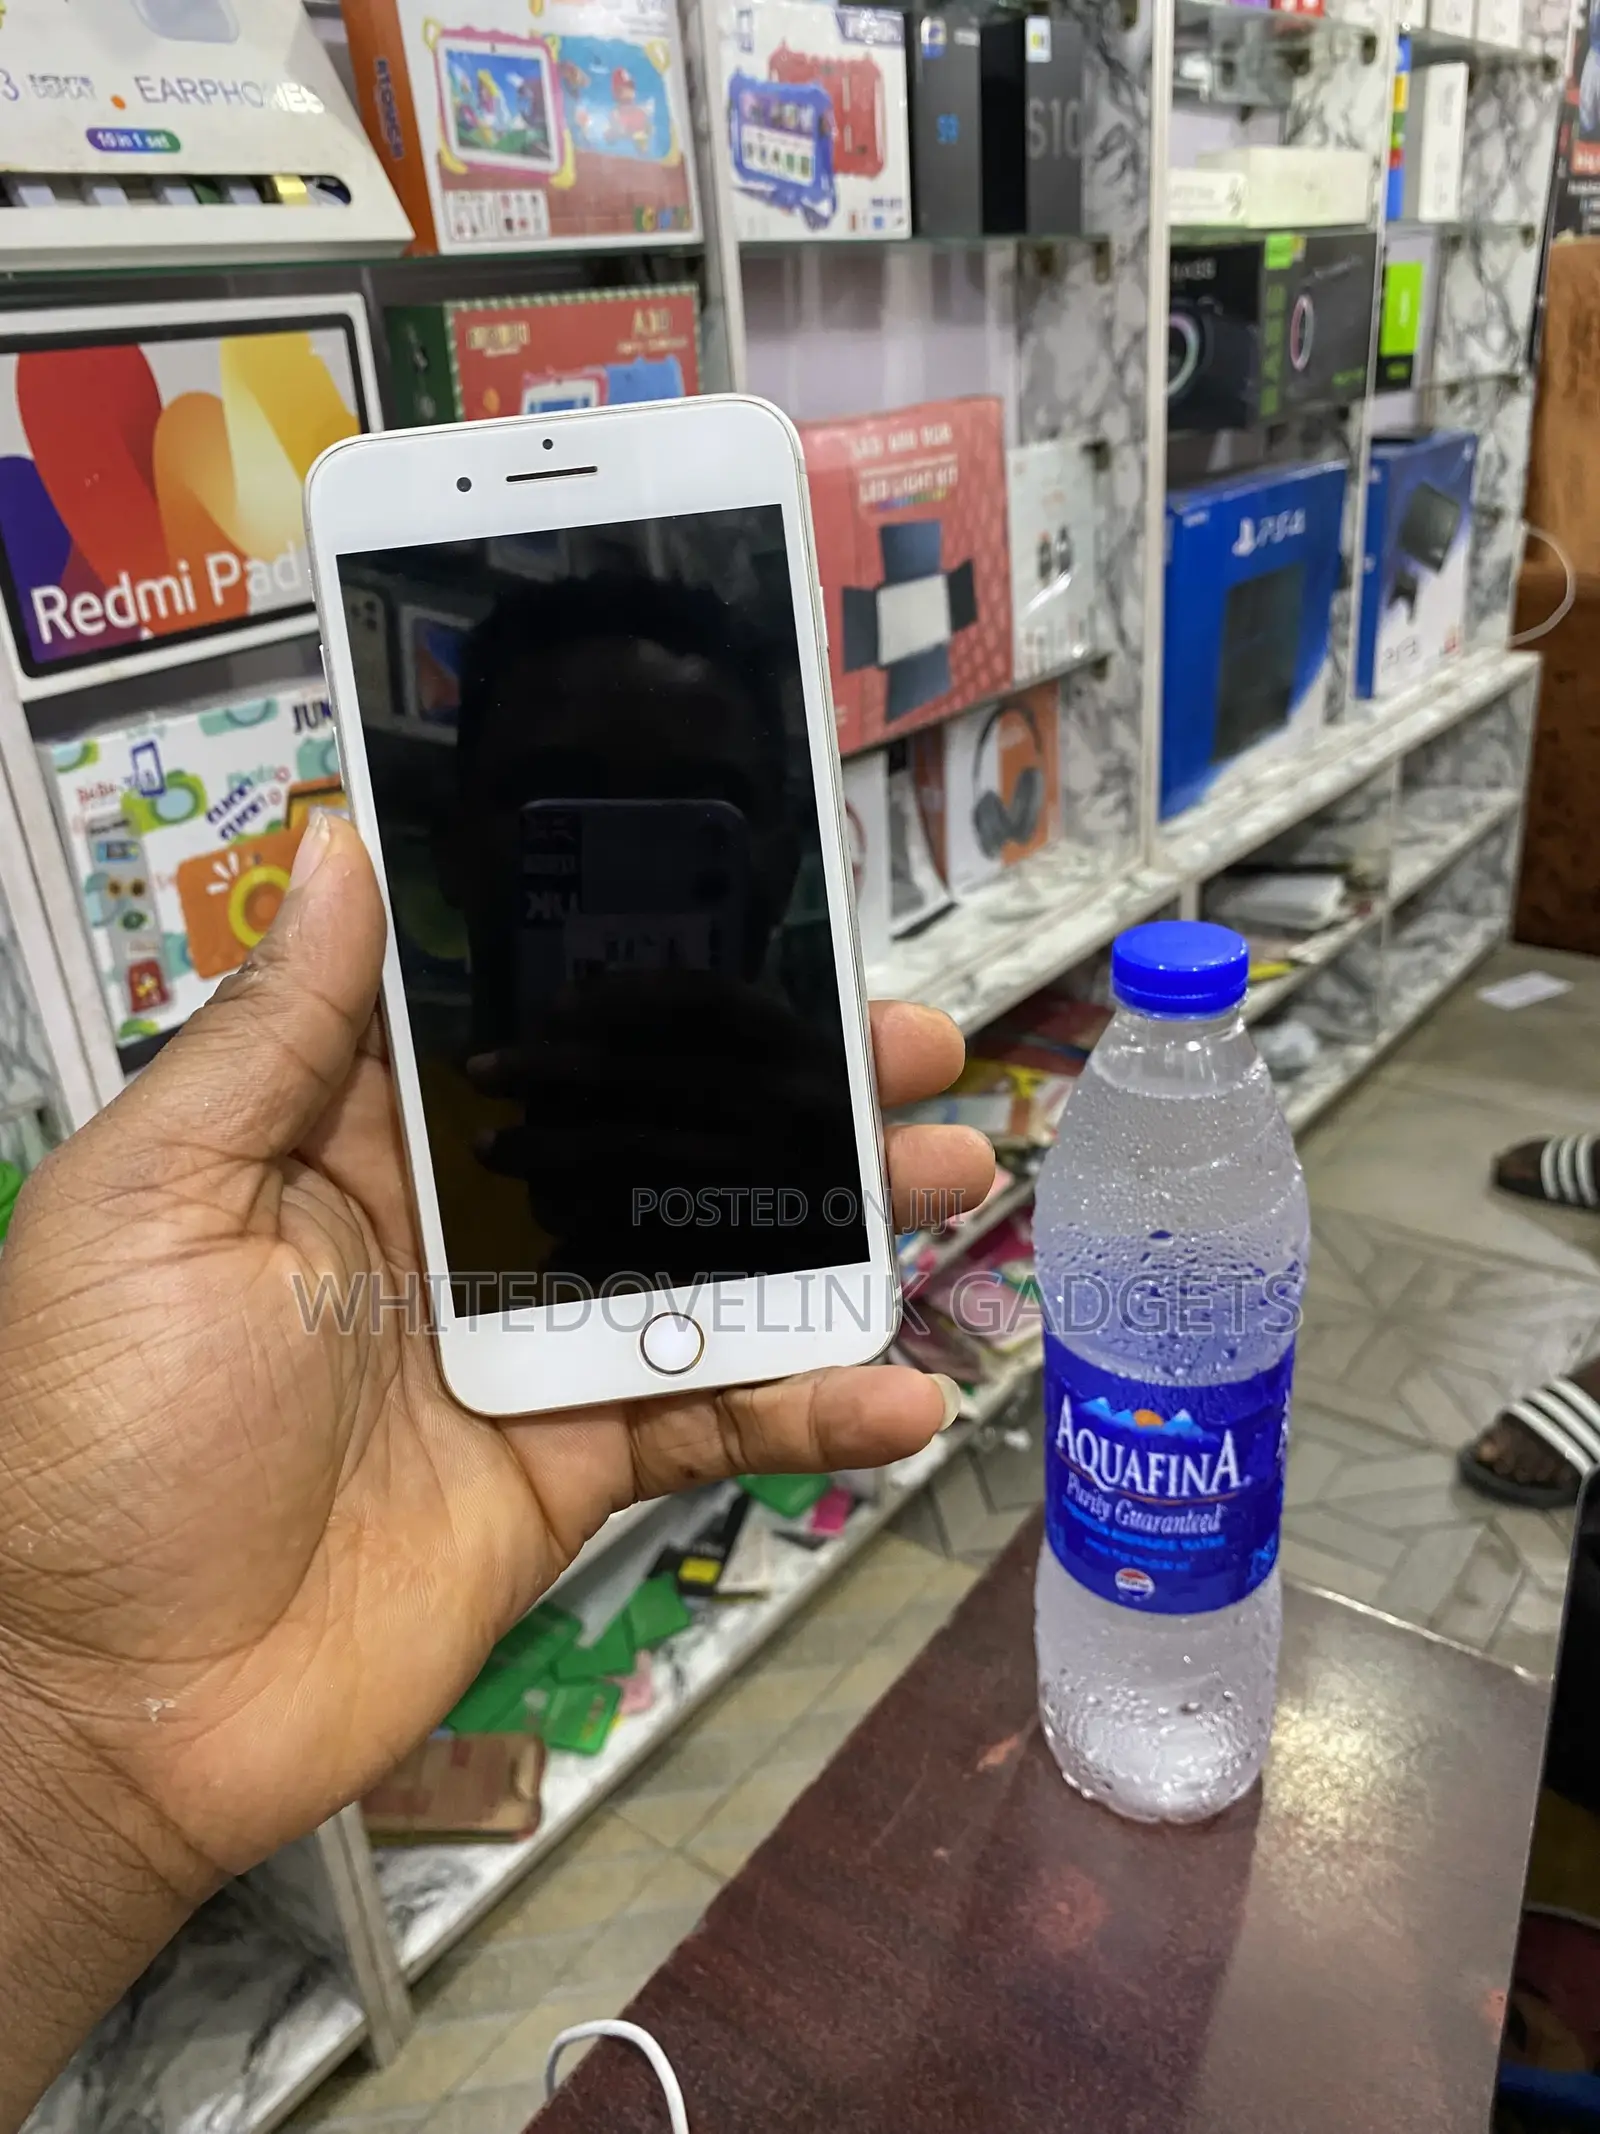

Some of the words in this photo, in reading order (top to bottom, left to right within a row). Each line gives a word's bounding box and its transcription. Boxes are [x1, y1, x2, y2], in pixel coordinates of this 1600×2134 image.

[30, 560, 197, 645] Redmi
[205, 540, 301, 608] Pad
[1055, 1394, 1242, 1498] AQUAFINA
[1066, 1470, 1113, 1523] Purity
[1115, 1498, 1222, 1535] Guaranteed
